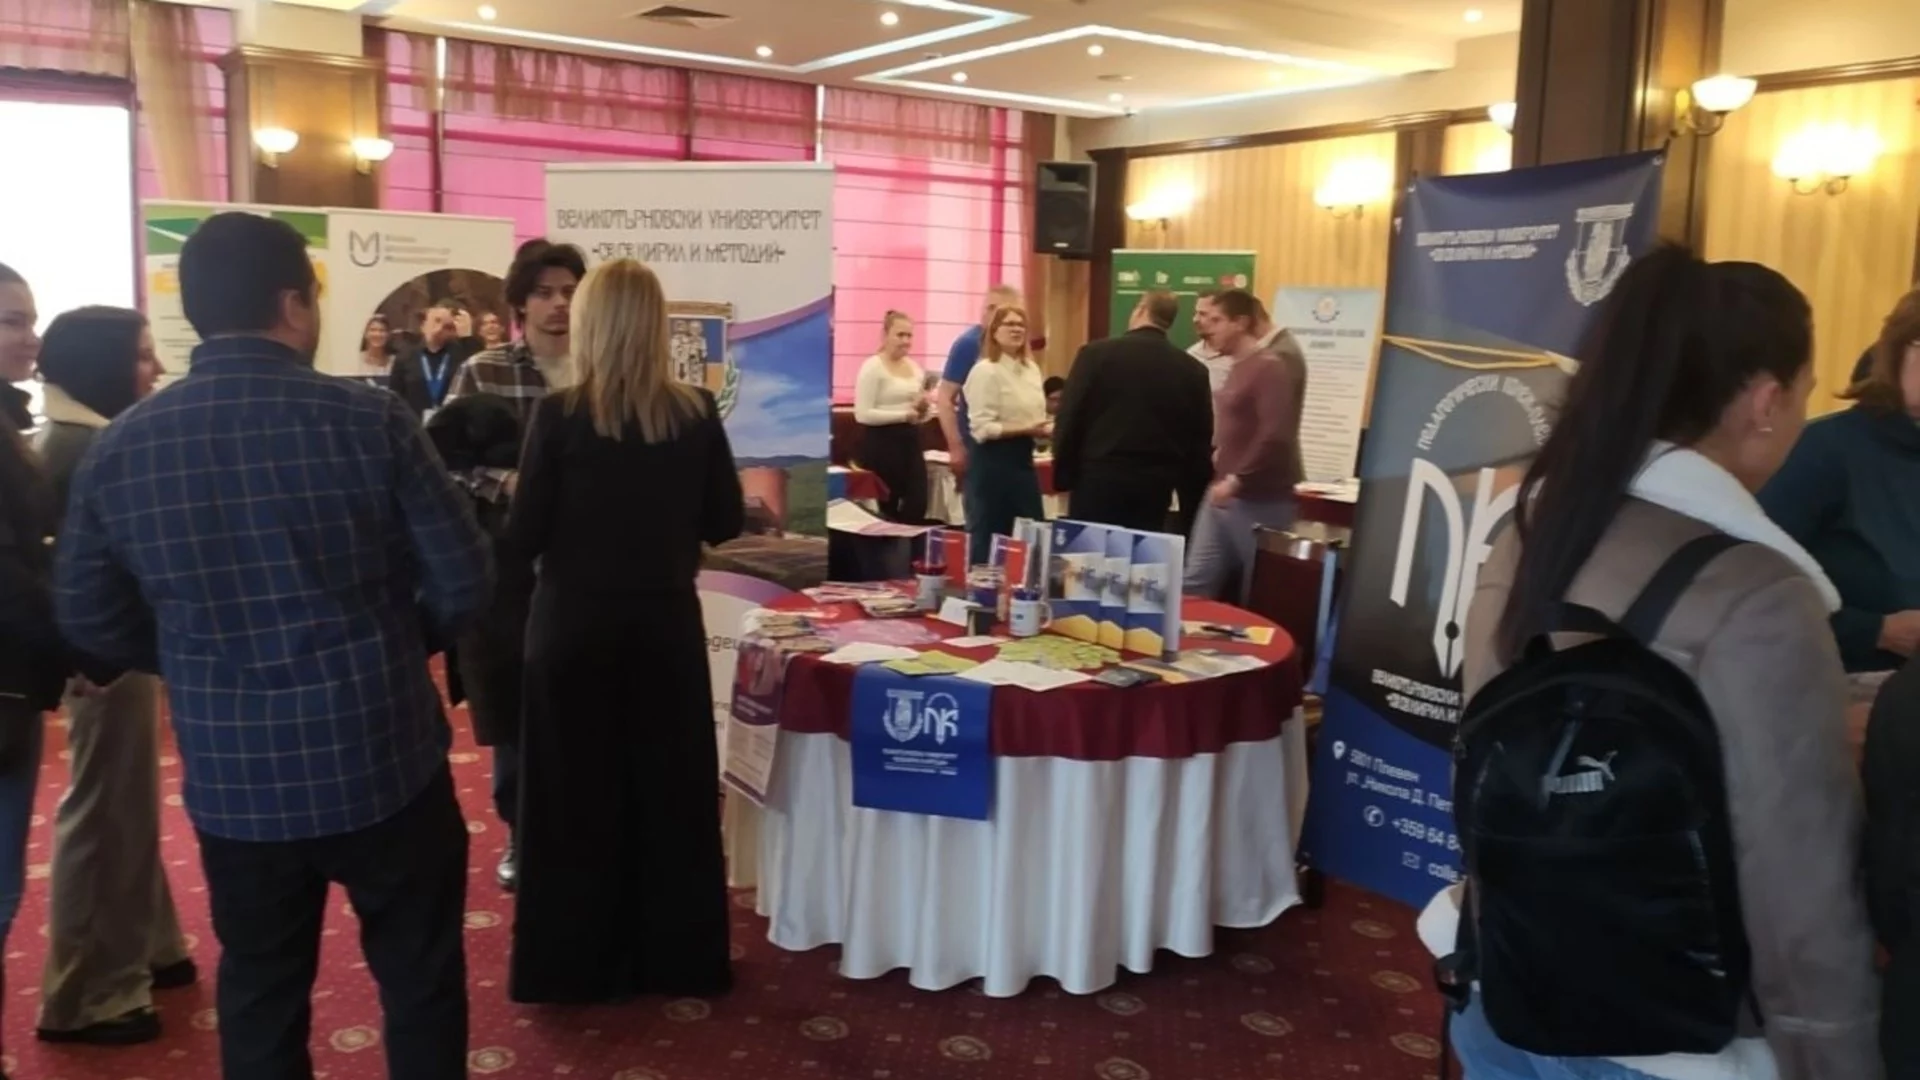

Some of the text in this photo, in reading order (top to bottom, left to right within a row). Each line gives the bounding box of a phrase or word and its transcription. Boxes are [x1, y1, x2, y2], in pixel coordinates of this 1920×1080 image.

[556, 208, 823, 230] ВЕЛИКОТЪРНОВСКИ УНИВЕРСИТЕТ
[690, 243, 701, 263] И
[1391, 817, 1426, 841] +359
